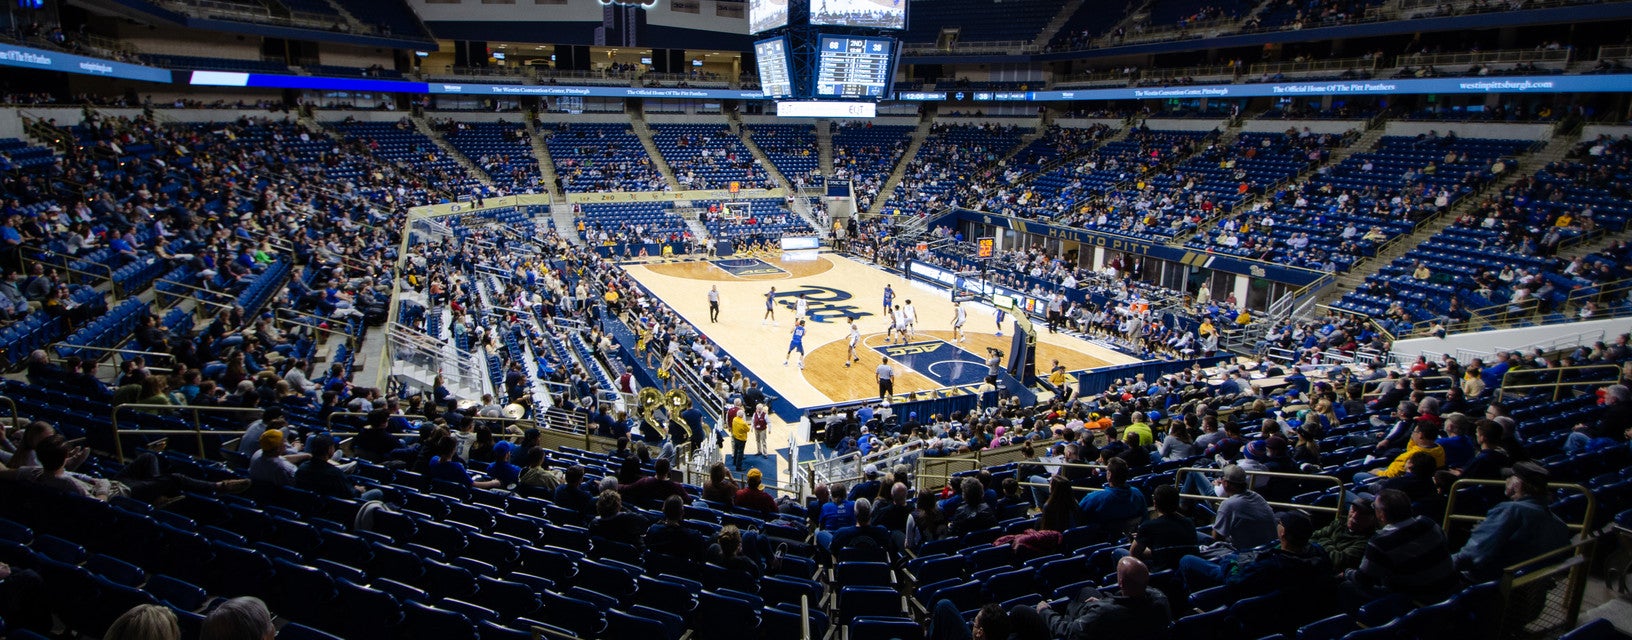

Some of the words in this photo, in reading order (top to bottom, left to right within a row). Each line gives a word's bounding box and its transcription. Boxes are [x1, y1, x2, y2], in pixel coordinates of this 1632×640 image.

[1202, 88, 1228, 96] Pittsburgh
[1364, 83, 1395, 91] Panthers
[1460, 80, 1553, 91] westinpittsburgh.com
[1049, 229, 1080, 241] HAIL
[1087, 235, 1107, 246] TO
[1113, 239, 1150, 255] PITT
[764, 285, 874, 324] Pitt
[885, 342, 944, 357] ACC
